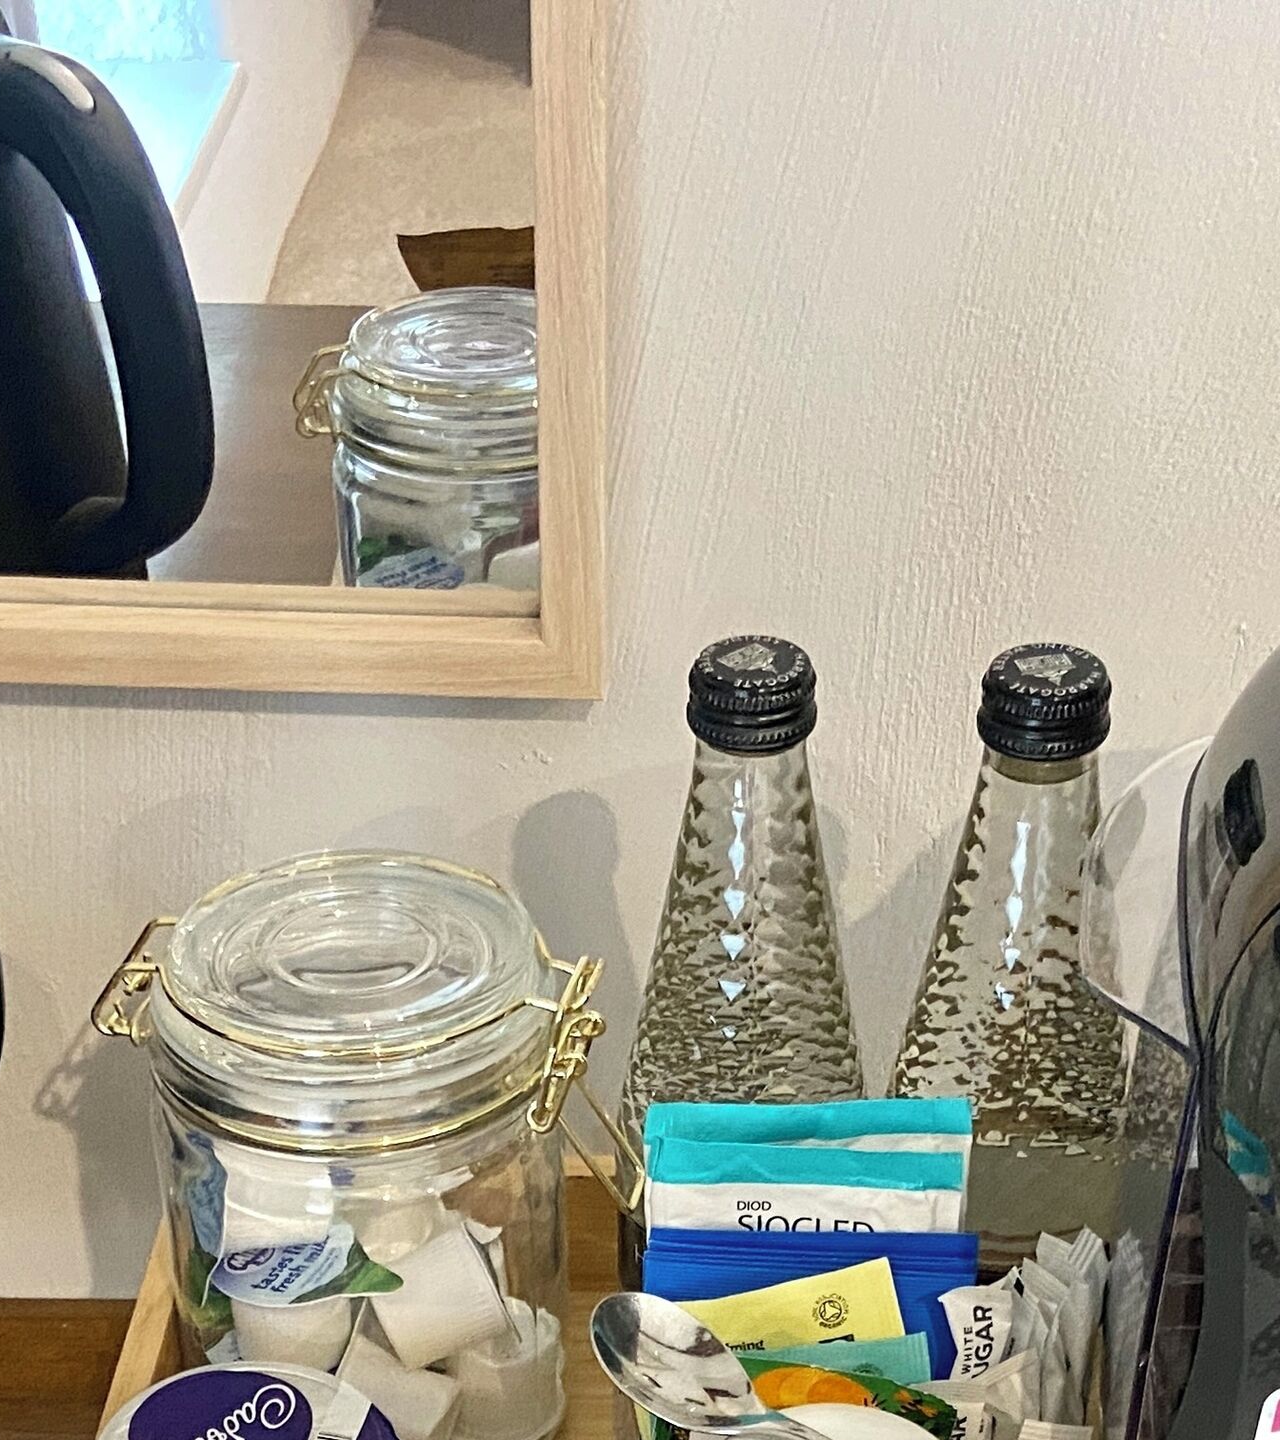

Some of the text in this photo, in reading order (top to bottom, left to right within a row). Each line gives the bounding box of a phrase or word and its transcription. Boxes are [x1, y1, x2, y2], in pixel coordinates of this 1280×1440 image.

[736, 1200, 772, 1212] DIOD
[271, 1264, 308, 1294] fresh
[724, 1339, 766, 1352] ming
[961, 1326, 974, 1376] WHITE
[971, 1305, 995, 1380] UGAR
